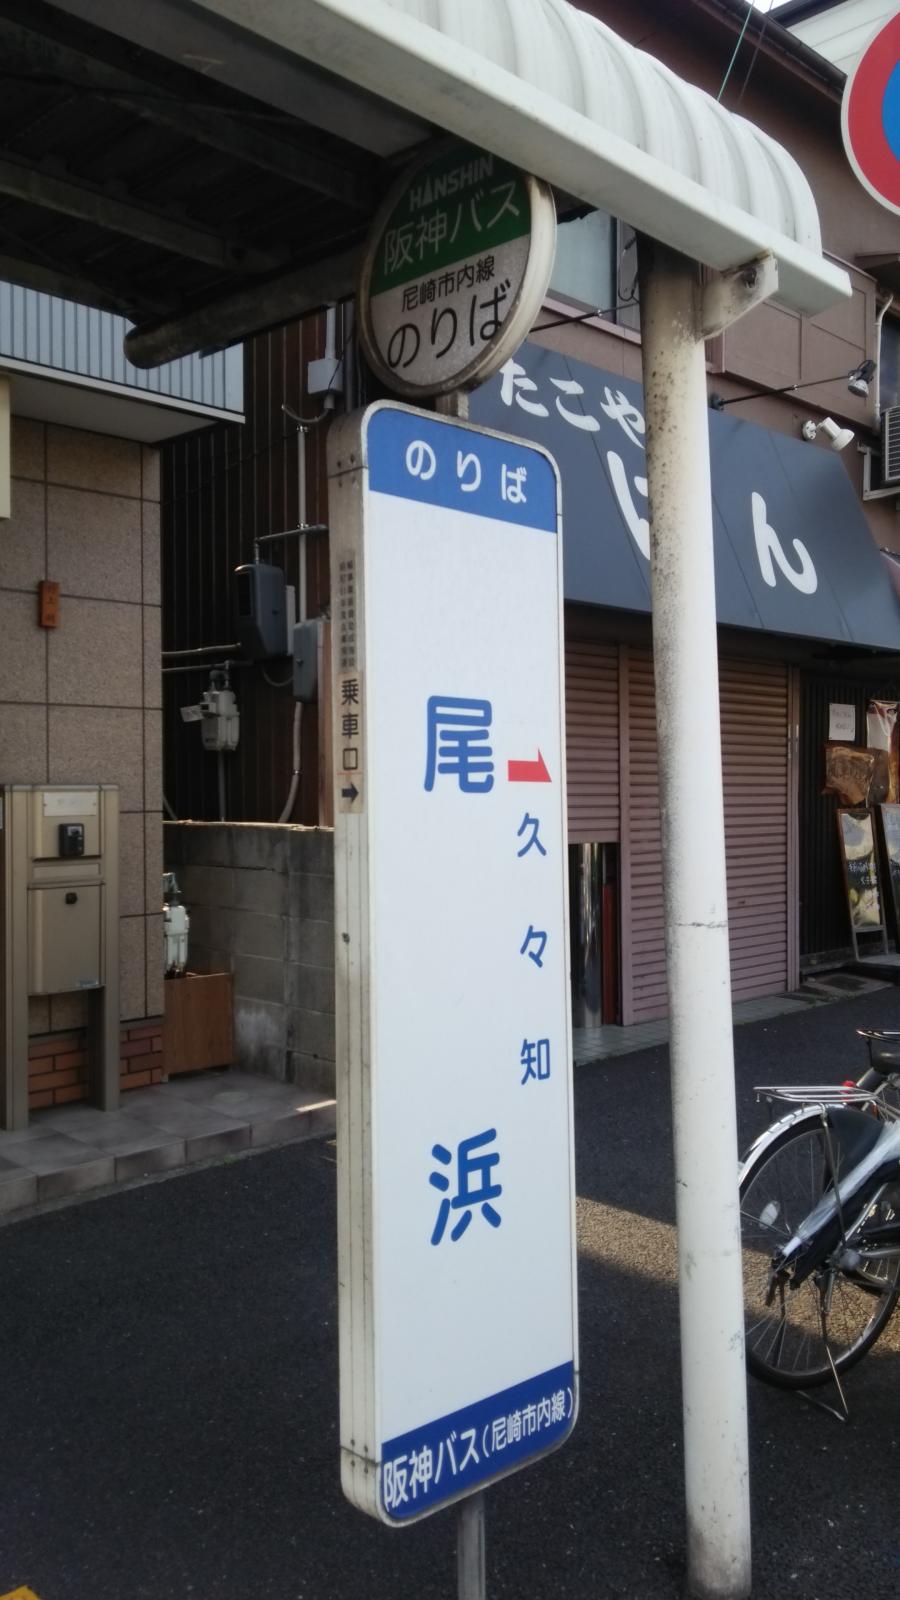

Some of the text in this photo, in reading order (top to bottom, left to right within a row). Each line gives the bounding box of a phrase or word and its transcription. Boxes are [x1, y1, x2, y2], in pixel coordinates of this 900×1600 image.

[384, 180, 521, 276] 阪神バス
[410, 154, 494, 212] HANSHIN
[387, 278, 512, 369] のりば
[402, 255, 496, 313] 尼崎市内線
[405, 440, 527, 504] のりば
[341, 679, 359, 771] 乗車口
[517, 812, 551, 1085] 久々知
